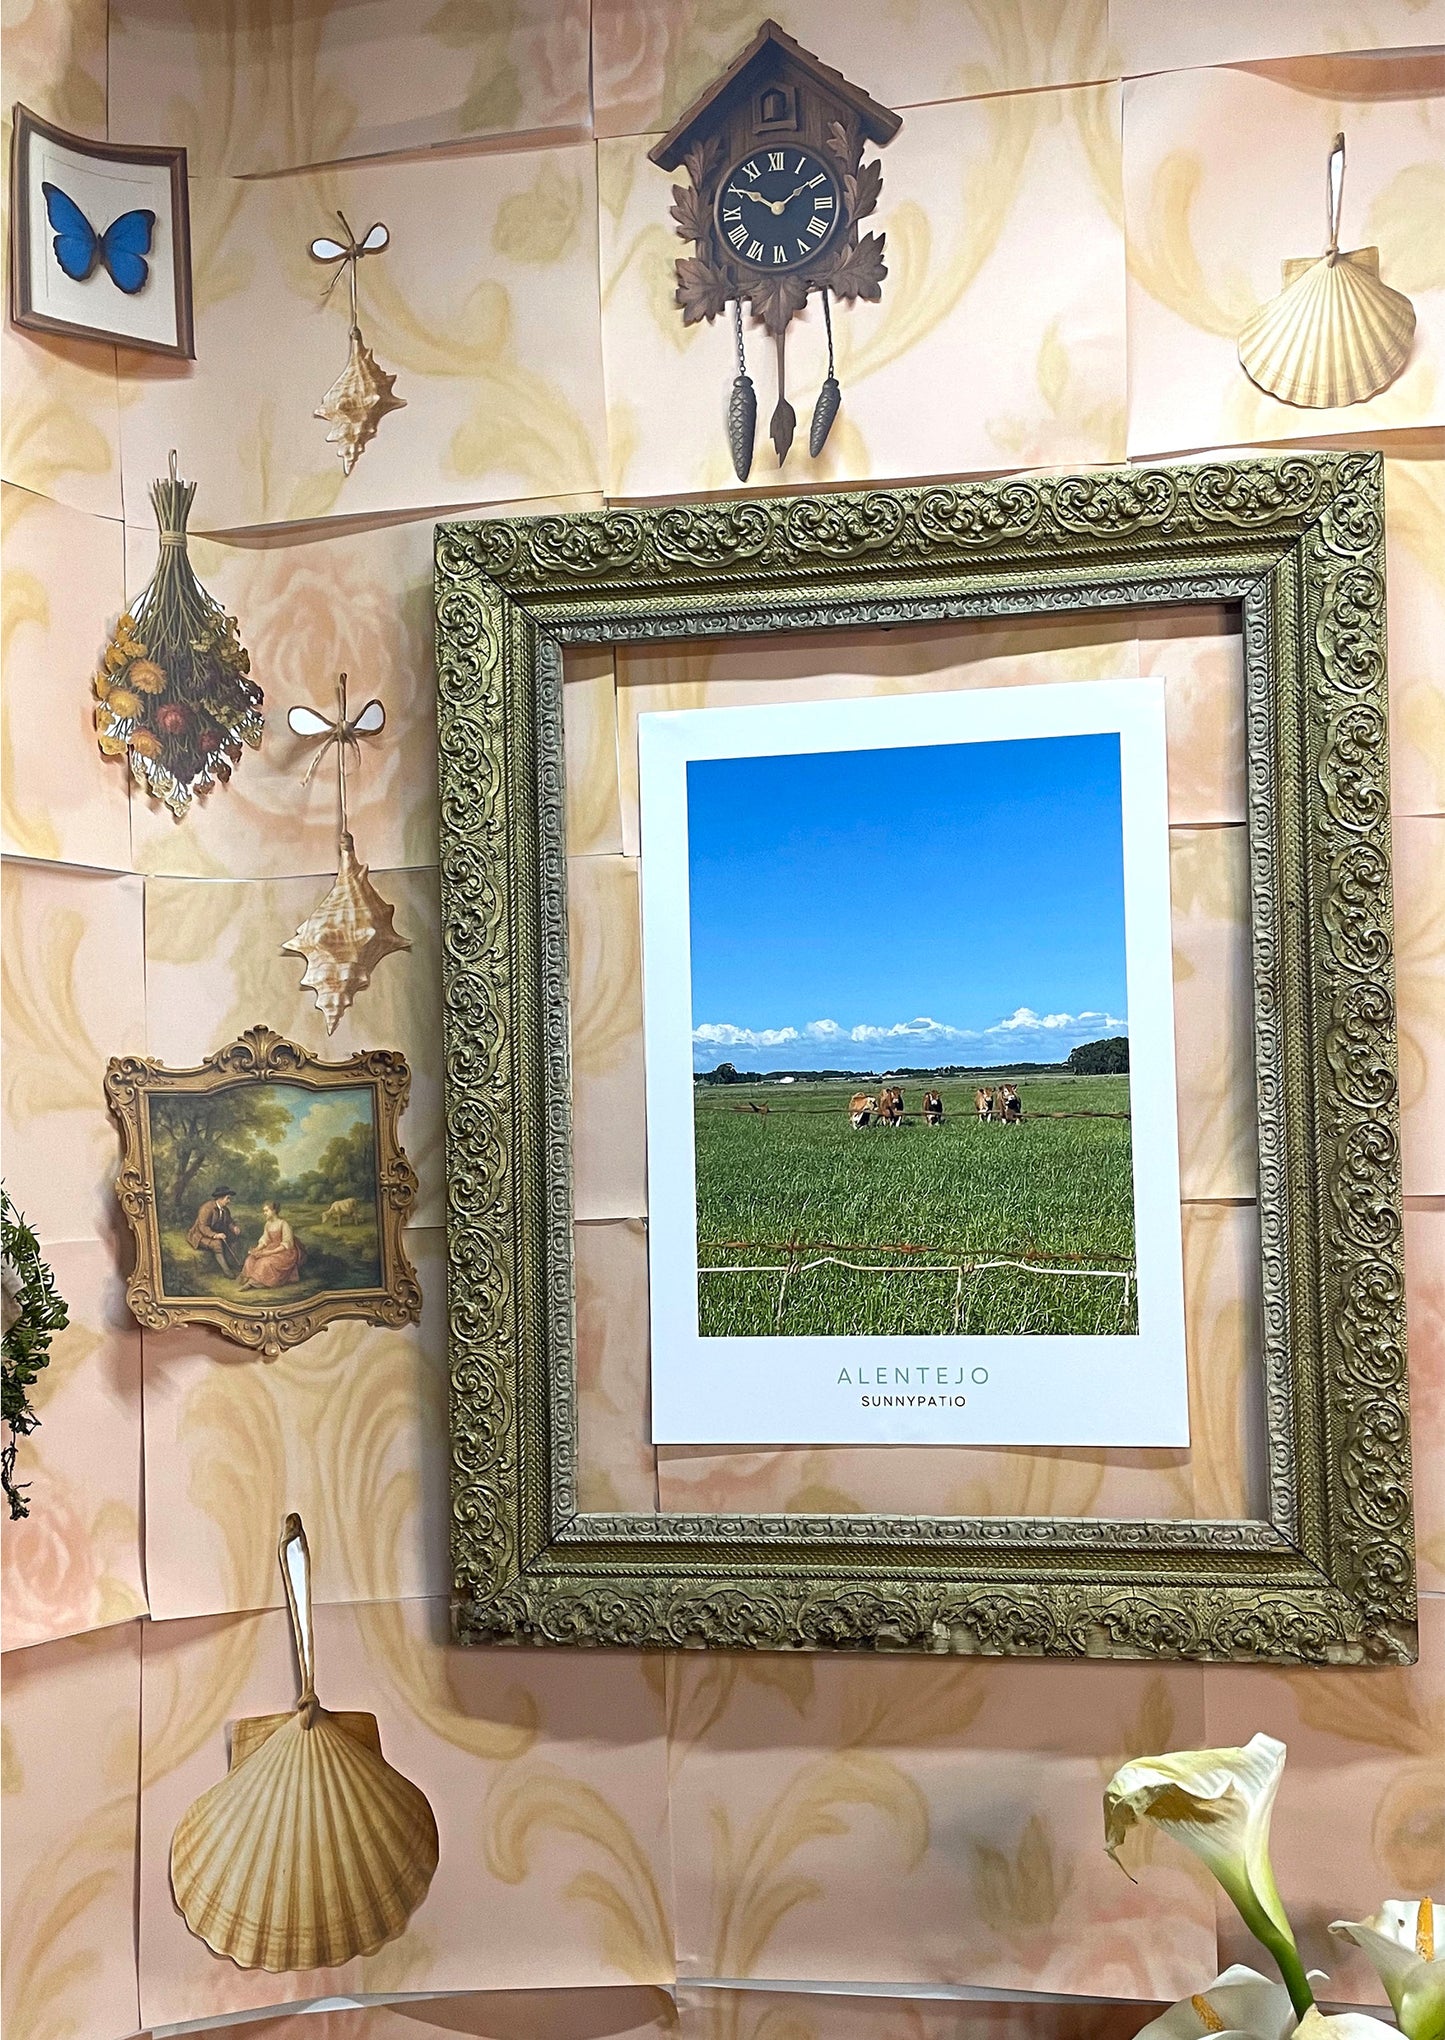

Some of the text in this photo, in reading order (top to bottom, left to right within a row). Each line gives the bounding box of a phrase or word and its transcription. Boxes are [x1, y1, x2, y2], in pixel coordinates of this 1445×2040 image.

[768, 152, 784, 171] XII
[795, 157, 806, 174] I
[742, 161, 761, 182] XI
[808, 173, 827, 189] II
[728, 182, 744, 199] X
[814, 196, 833, 210] III
[723, 206, 741, 222] IX
[806, 216, 829, 238] IIII
[728, 224, 749, 250] VIII
[746, 240, 764, 261] VII
[773, 245, 788, 263] VI
[797, 238, 811, 255] V
[837, 1367, 989, 1385] ALENTEJO
[861, 1395, 966, 1407] SUNNYPATIO
